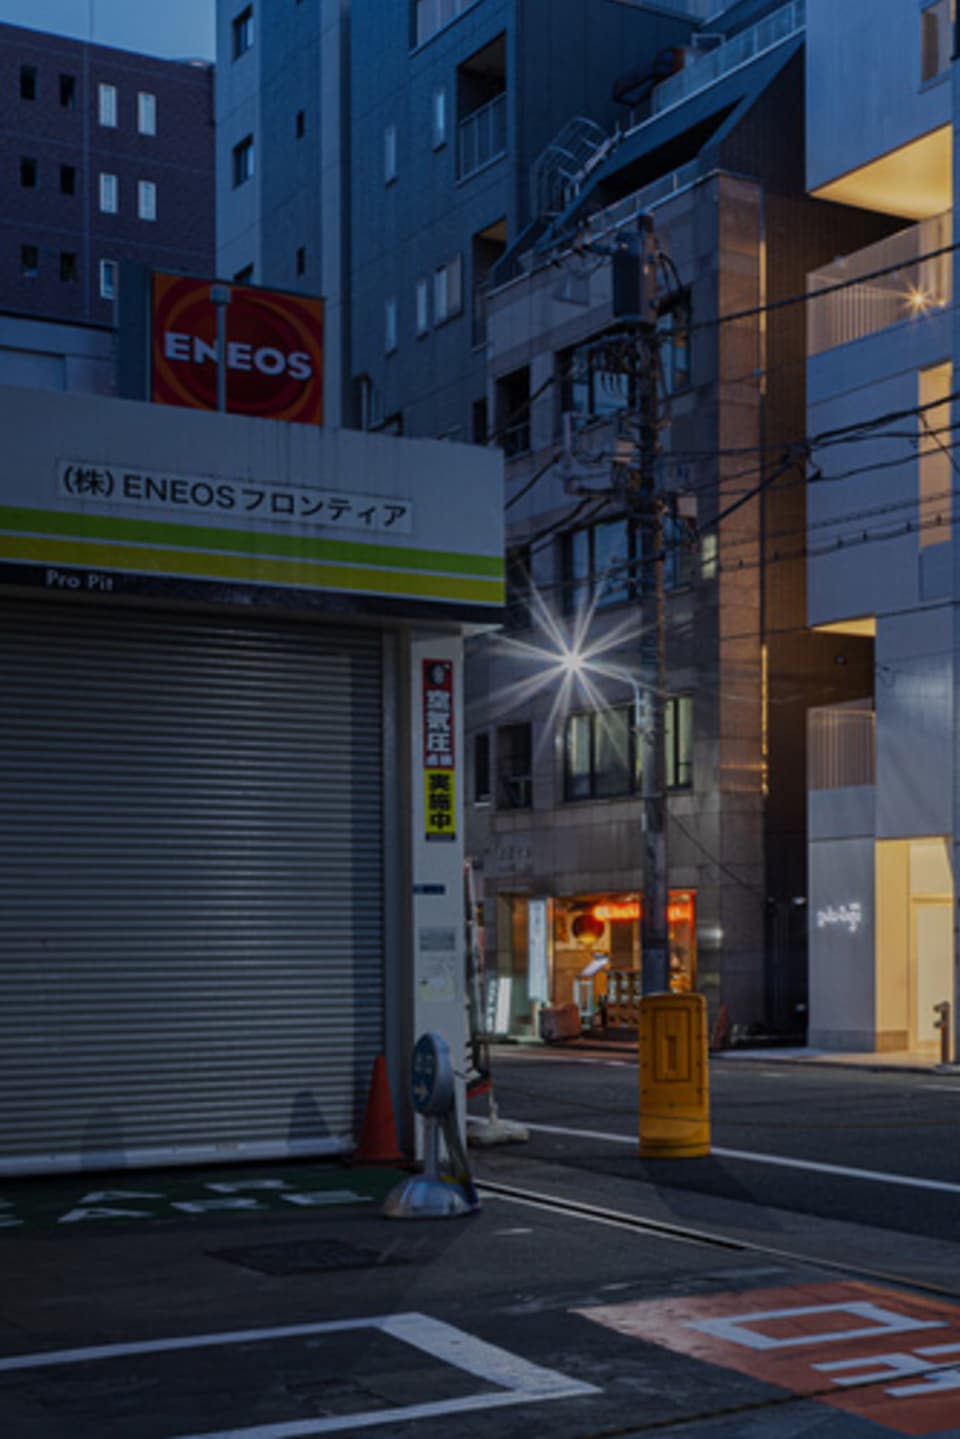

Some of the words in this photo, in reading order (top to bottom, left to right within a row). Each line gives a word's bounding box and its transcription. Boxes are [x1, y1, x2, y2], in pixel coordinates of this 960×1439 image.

[164, 331, 313, 381] ENEOS
[46, 570, 81, 590] Pro
[88, 574, 114, 592] Pit
